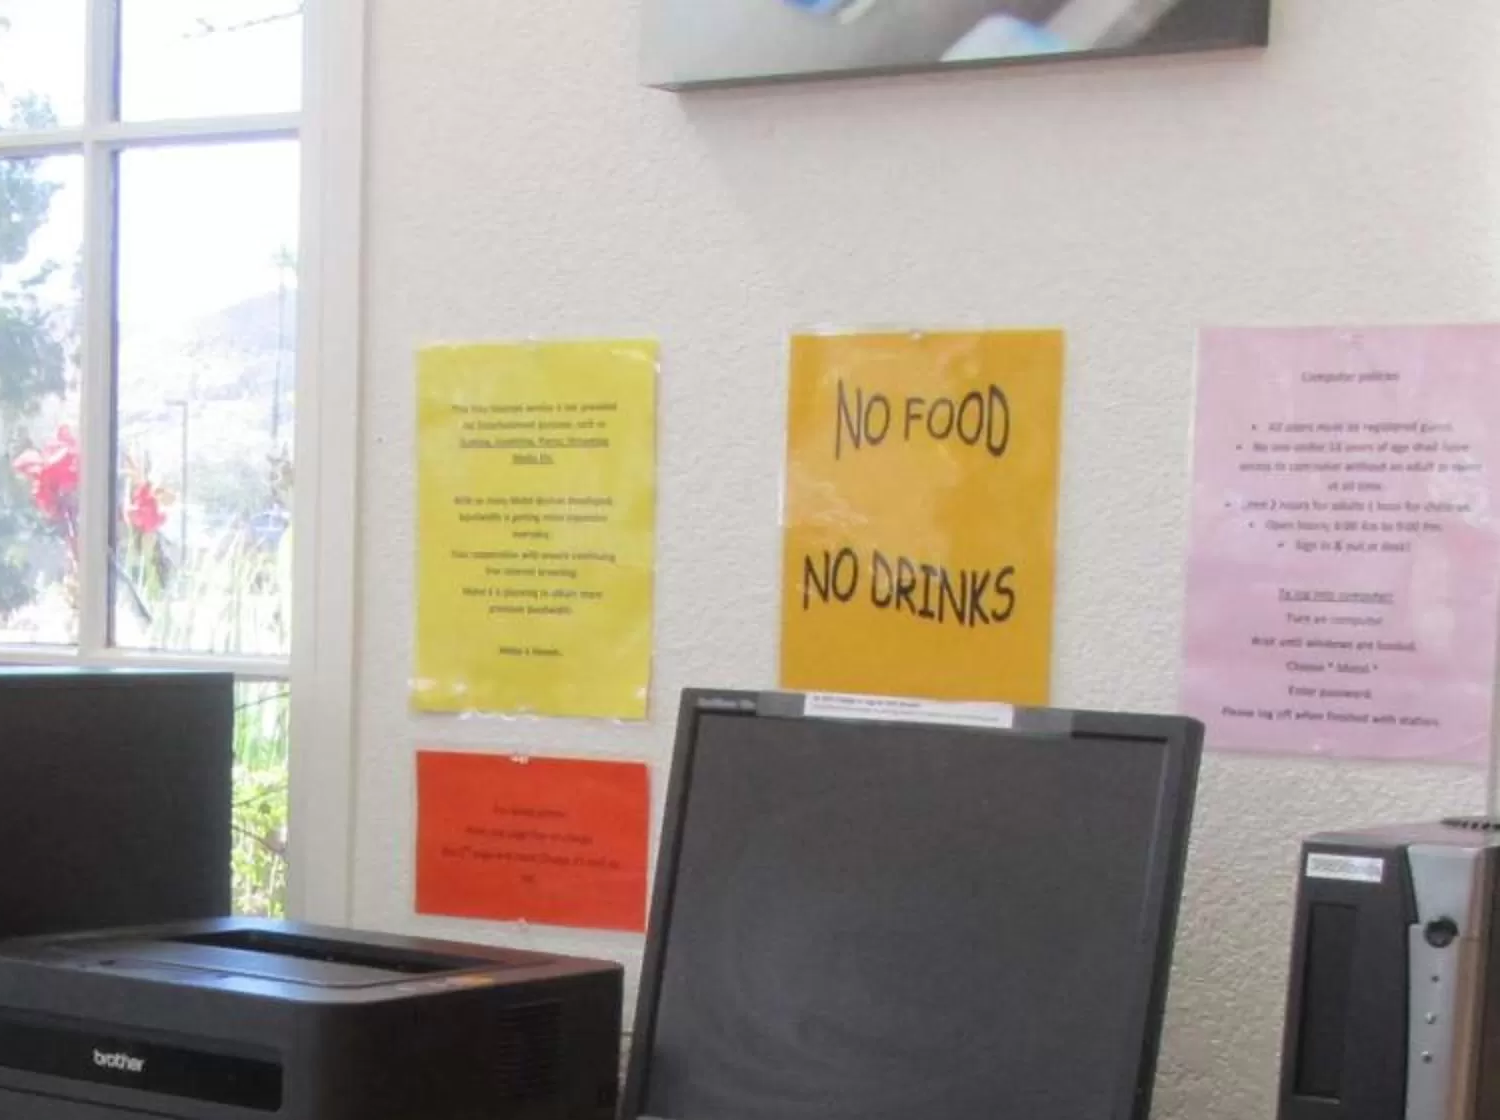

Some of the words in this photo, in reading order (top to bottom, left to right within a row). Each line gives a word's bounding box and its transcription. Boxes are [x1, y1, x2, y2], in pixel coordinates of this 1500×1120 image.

[1301, 371, 1355, 384] Computer
[834, 378, 892, 461] NO
[903, 383, 1012, 458] FOOD
[802, 546, 860, 611] NO
[871, 550, 1017, 628] DRINKS
[1288, 685, 1317, 697] Enter
[1221, 705, 1255, 718] Please
[93, 1048, 144, 1072] brother
